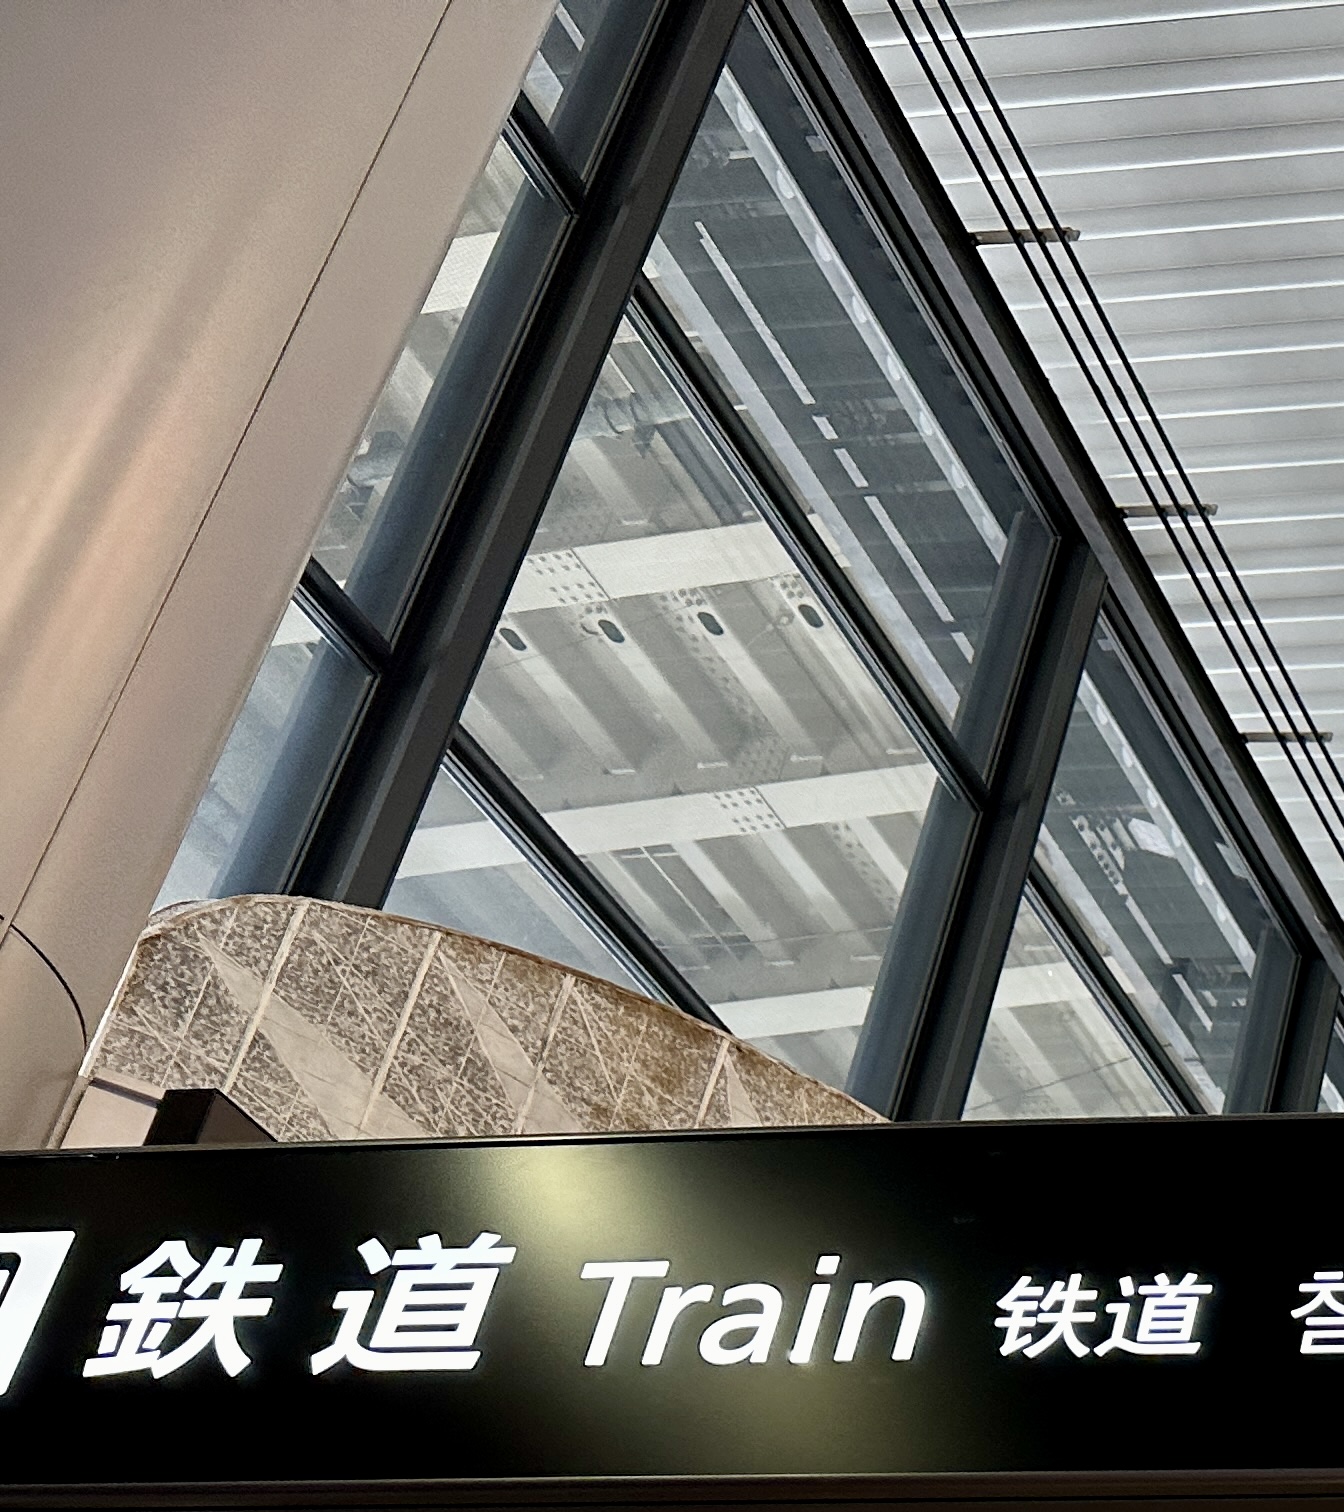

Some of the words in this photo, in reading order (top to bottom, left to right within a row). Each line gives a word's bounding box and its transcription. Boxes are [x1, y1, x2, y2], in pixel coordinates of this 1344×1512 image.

[83, 1233, 513, 1379] 鉄道
[577, 1255, 927, 1367] Train
[995, 1273, 1213, 1359] 铁道
